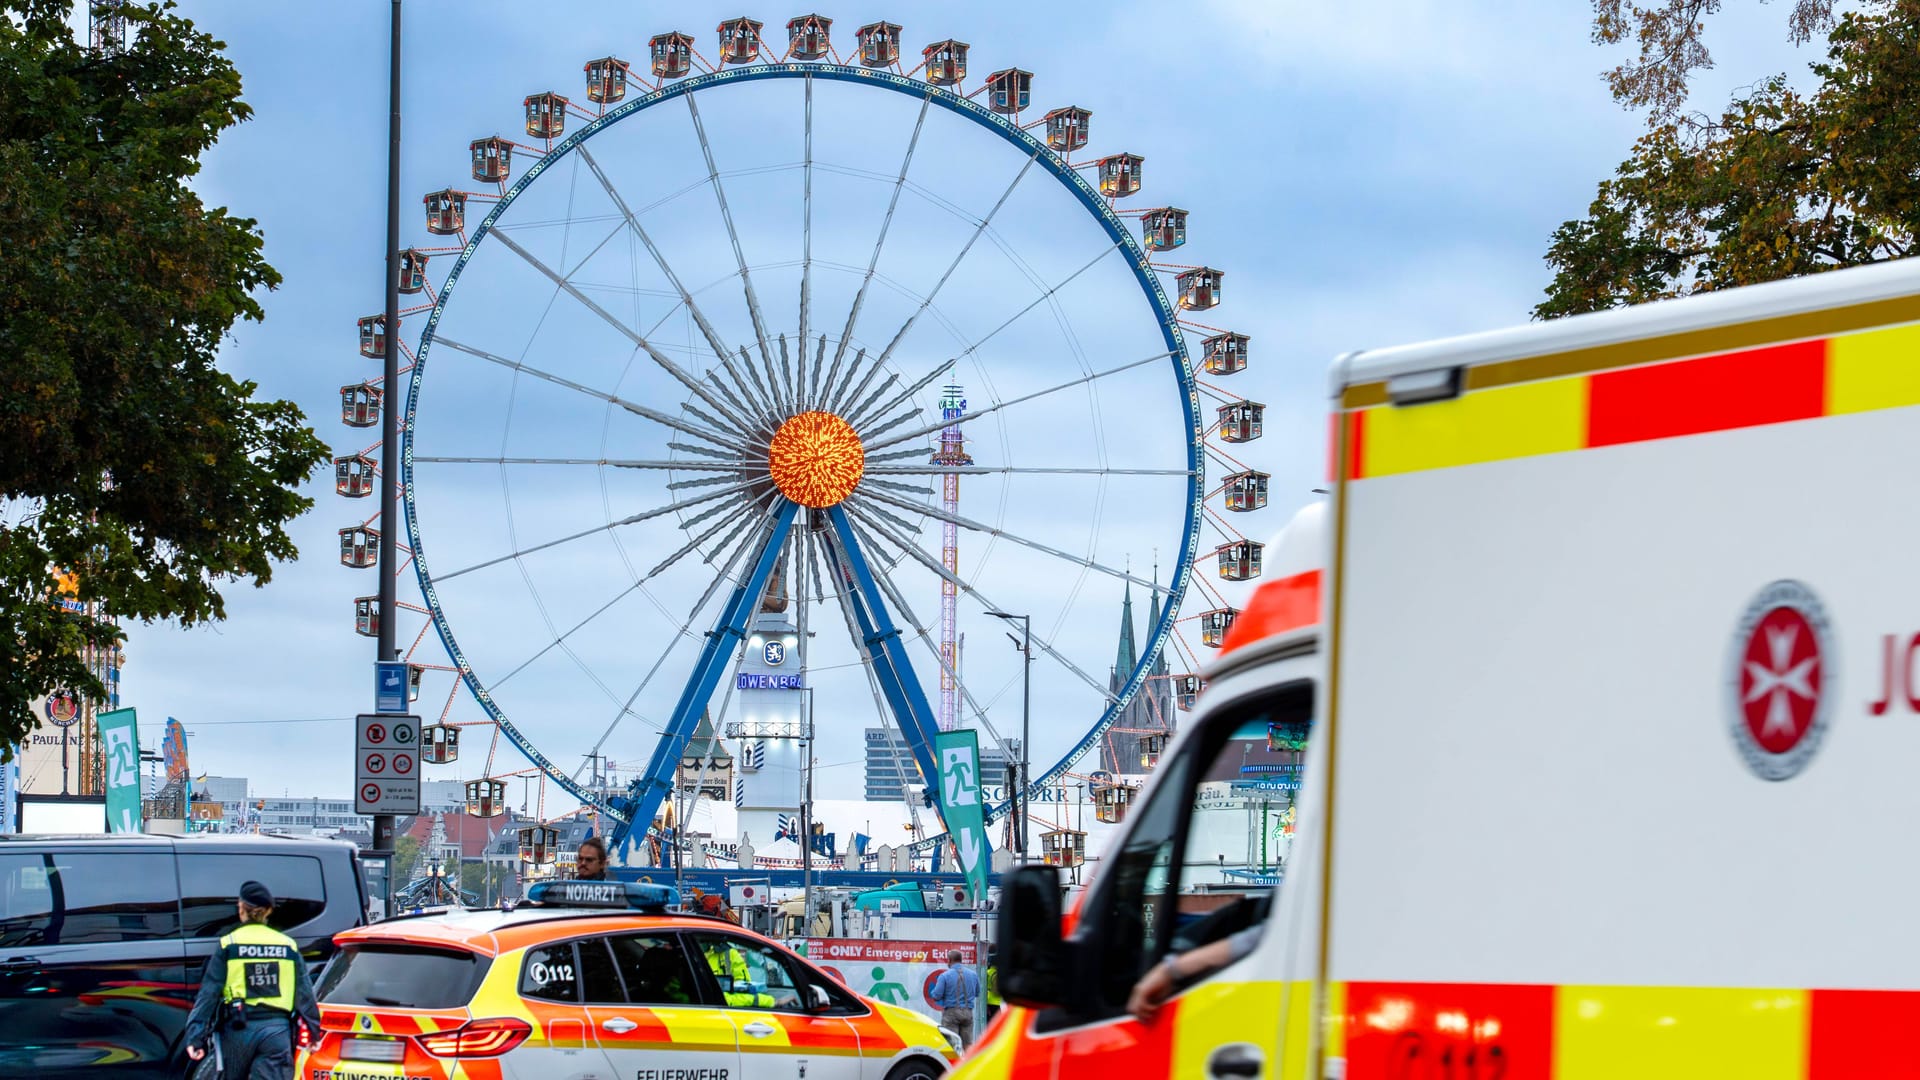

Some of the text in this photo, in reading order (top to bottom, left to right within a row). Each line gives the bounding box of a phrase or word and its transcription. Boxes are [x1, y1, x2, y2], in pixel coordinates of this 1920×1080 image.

[737, 672, 802, 690] LÖWENBRÄ
[867, 732, 885, 741] ARD
[566, 884, 617, 902] NOTARZT
[238, 946, 287, 958] POLIZEI
[829, 945, 864, 957] ONLY
[866, 947, 929, 962] Emergency
[932, 949, 949, 960] Exi
[255, 964, 270, 975] BY
[549, 965, 575, 981] 112
[248, 974, 278, 986] 1311
[637, 1069, 729, 1080] FEUERWEHR
